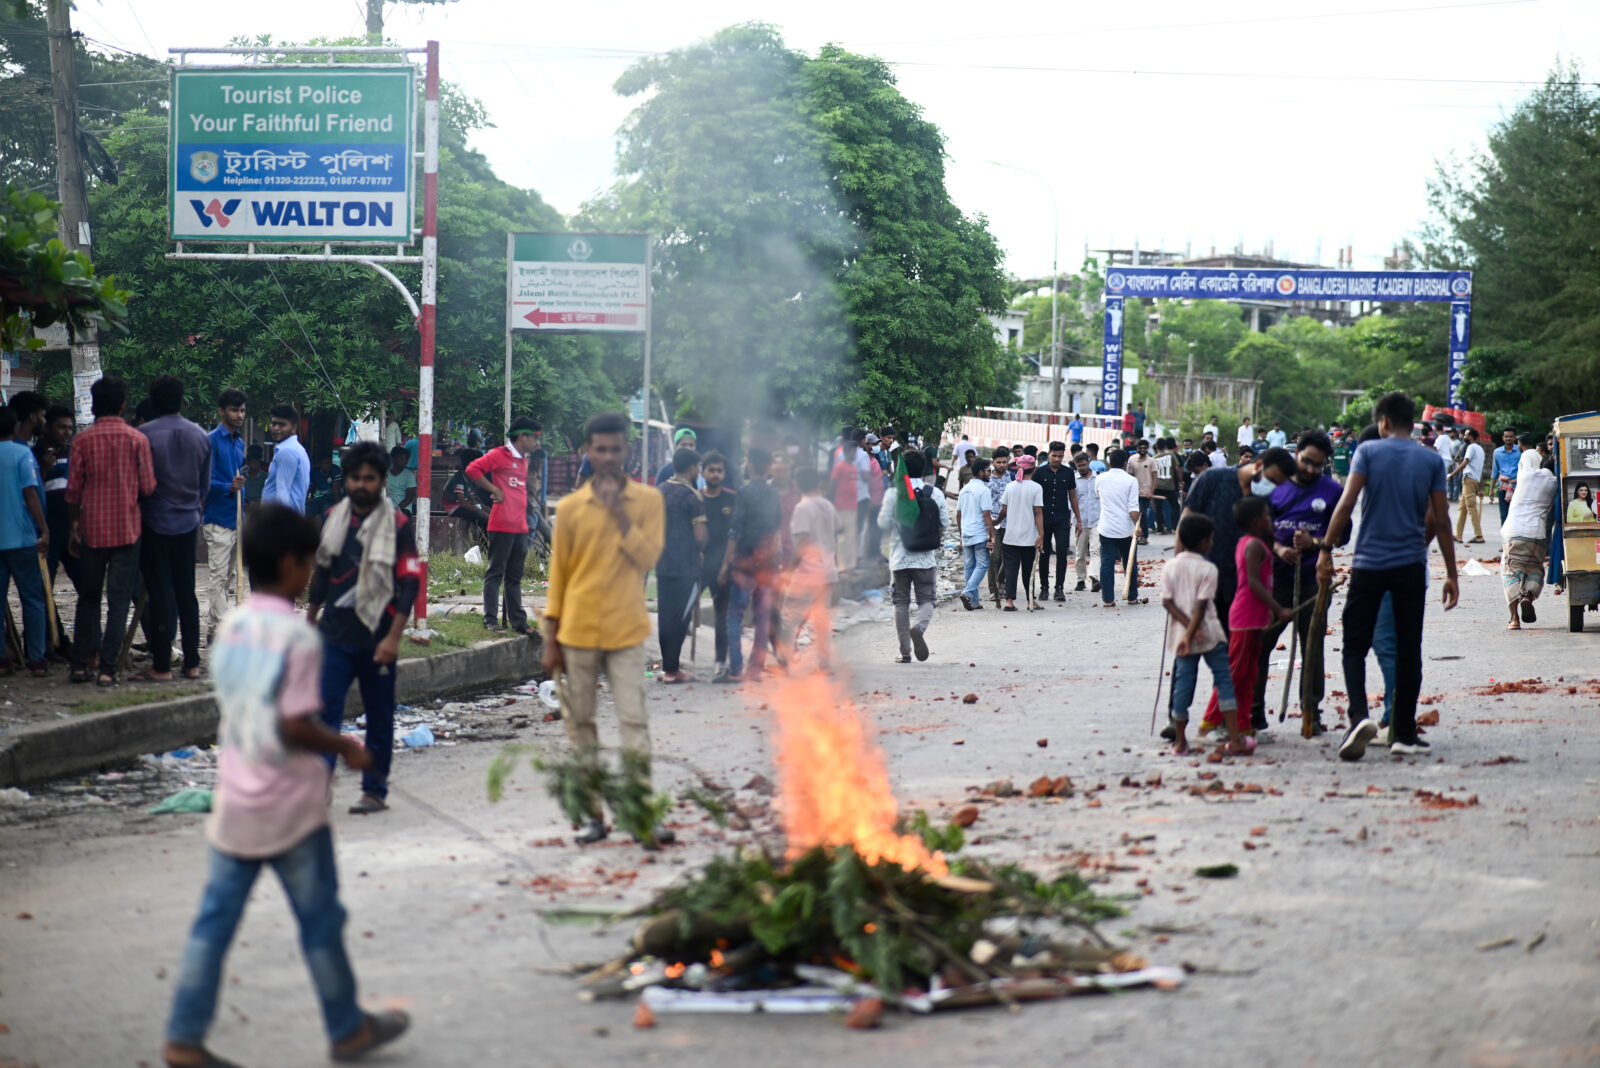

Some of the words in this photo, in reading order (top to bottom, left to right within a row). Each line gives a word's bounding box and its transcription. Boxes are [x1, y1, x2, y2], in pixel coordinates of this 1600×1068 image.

[220, 85, 292, 104] Tourist
[298, 85, 362, 104] Police
[189, 114, 237, 132] Your
[243, 113, 320, 132] Faithful
[326, 113, 393, 132] Friend
[223, 149, 311, 175] ট্যুরিস্ট
[319, 149, 392, 175] পুলিশ
[223, 176, 262, 186] Helpline:
[264, 176, 328, 186] 01320-222222,
[251, 200, 393, 227] WALTON
[1126, 274, 1168, 292] বাংলাদেশ
[1169, 271, 1198, 292] মেরিন
[1199, 272, 1239, 292] একাডেমি
[1241, 272, 1276, 293] বরিশাল
[1298, 277, 1347, 294] BANGLADESH
[1348, 277, 1376, 295] MARINE
[1376, 277, 1413, 295] ACADEMY
[1414, 278, 1451, 296] BARISHAL
[1103, 344, 1119, 411] WELCOME
